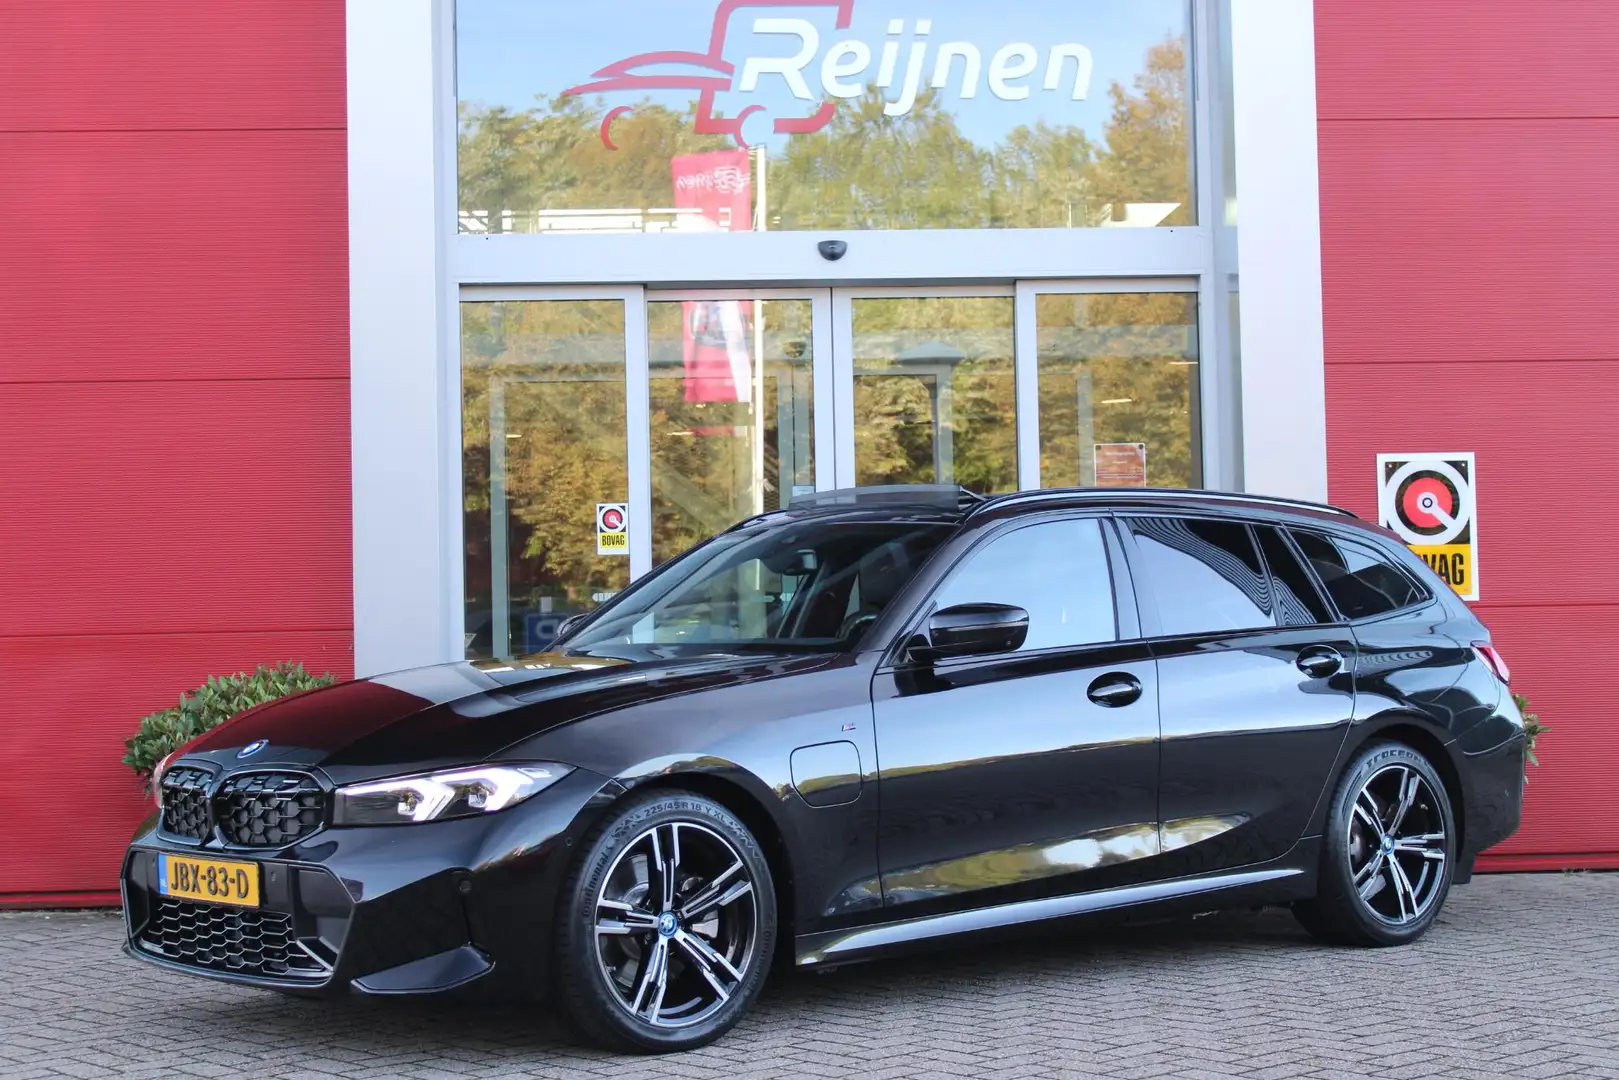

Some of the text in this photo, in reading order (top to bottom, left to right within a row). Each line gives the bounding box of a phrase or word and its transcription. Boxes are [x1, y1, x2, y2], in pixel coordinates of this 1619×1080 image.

[739, 18, 1094, 116] Reijnen
[601, 534, 625, 546] BOVAG
[1418, 553, 1464, 585] VAG
[644, 802, 680, 816] 225/45
[171, 862, 249, 899] JBX-83-D
[582, 852, 609, 917] Continental
